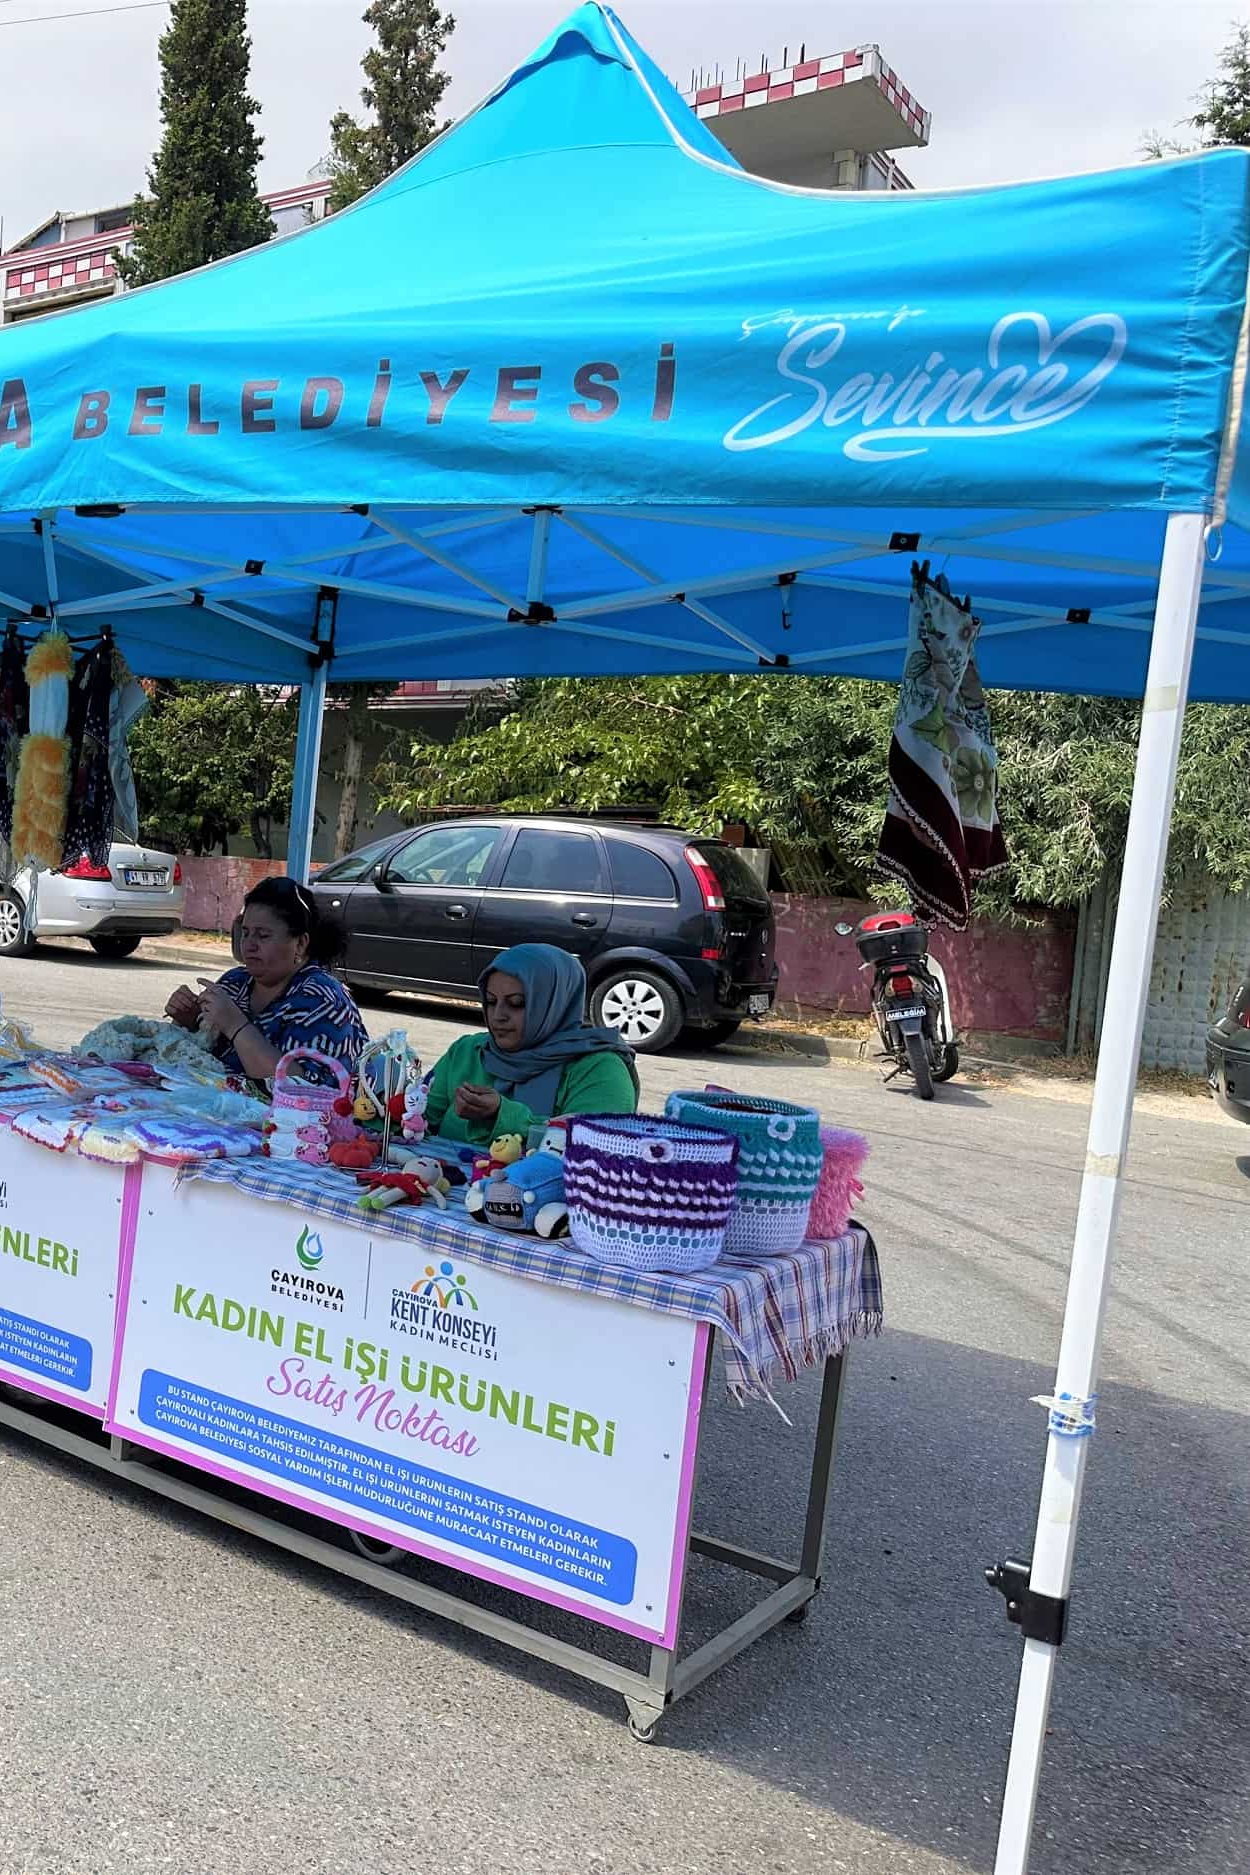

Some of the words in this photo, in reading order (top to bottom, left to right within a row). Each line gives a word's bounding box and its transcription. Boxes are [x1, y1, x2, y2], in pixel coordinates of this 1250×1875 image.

[72, 342, 677, 440] BELEDİYESİ
[723, 311, 1127, 461] Sevince
[271, 1269, 344, 1301] ÇAYIROVA
[271, 1284, 344, 1313] BELEDİYESİ
[391, 1288, 438, 1308] ÇAYIROVA
[391, 1297, 430, 1326] KENT
[431, 1309, 498, 1348] KONSEYİ
[173, 1284, 284, 1347] KADIN
[293, 1321, 333, 1364] EL
[343, 1341, 390, 1385] İŞİ
[400, 1355, 617, 1457] ÜRÜNLERİ
[390, 1319, 435, 1342] KADIN
[438, 1335, 498, 1361] MECLİSİ
[155, 1409, 198, 1433] ÇAYIROVA
[248, 1444, 282, 1465] SOSYAL
[284, 1457, 321, 1481] YARDIM
[266, 1357, 348, 1417] Satış
[354, 1384, 480, 1457] Noktası
[156, 1395, 206, 1421] ÇAYIROVALI
[207, 1412, 260, 1441] KADINLARA
[352, 1467, 363, 1480] EL
[444, 1501, 490, 1525] SATMAK
[538, 1535, 612, 1570] KADINLARIN
[168, 1384, 180, 1396] BU
[181, 1388, 210, 1407] STAND
[211, 1400, 255, 1424] ÇAYIROVA
[318, 1439, 382, 1470] TARAFINDAN
[384, 1463, 395, 1476] EL
[474, 1495, 505, 1516] SATIŞ
[506, 1506, 547, 1530] STANDI
[550, 1523, 598, 1549] OLARAK
